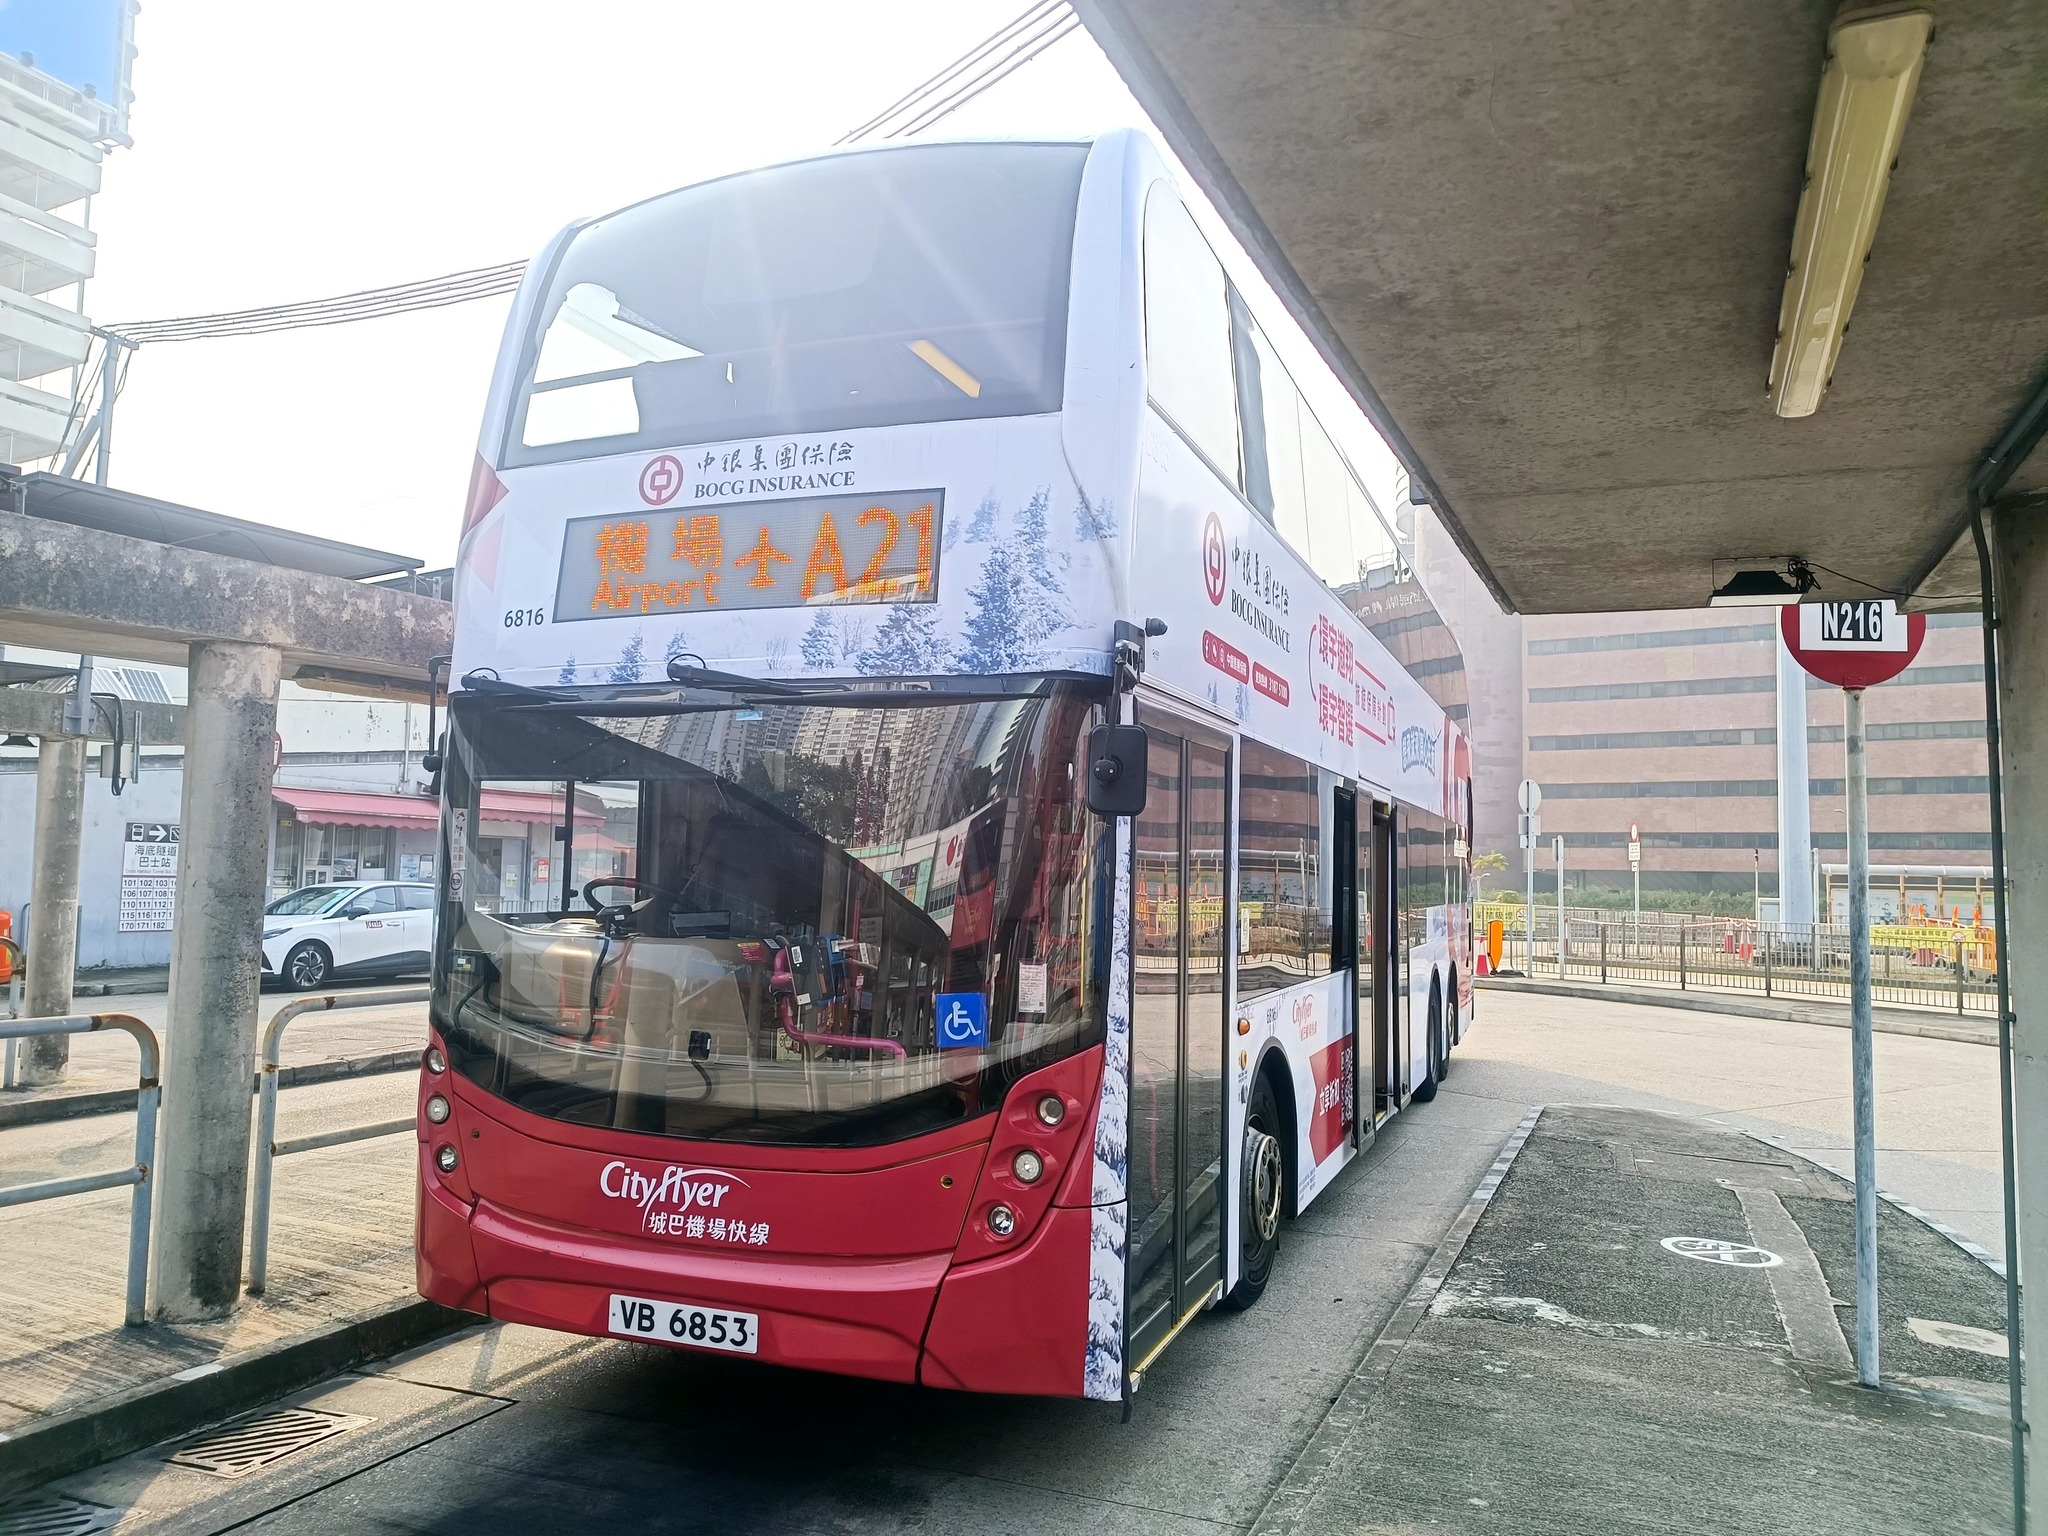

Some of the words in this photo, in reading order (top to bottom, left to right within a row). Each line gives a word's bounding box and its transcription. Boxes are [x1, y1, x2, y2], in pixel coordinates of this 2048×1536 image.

[697, 441, 855, 477] 中銀集團保險
[694, 479, 745, 499] BOCG
[748, 470, 855, 494] INSURANCE
[594, 514, 724, 576] 機場
[801, 503, 932, 599] A21
[591, 570, 721, 613] Airport
[503, 609, 545, 628] 6816
[1231, 588, 1254, 626] BOCG
[1253, 605, 1291, 654] INSURANCE
[1823, 602, 1881, 640] N216
[134, 845, 177, 857] 海底隧道
[139, 856, 171, 868] 巴士站
[124, 879, 136, 887] 101
[140, 879, 153, 887] 102
[155, 879, 168, 887] 103
[600, 1161, 733, 1214] Cityflyer
[648, 1211, 770, 1246] 城巴機場快線
[620, 1300, 655, 1332] VB
[669, 1308, 748, 1347] 6853
